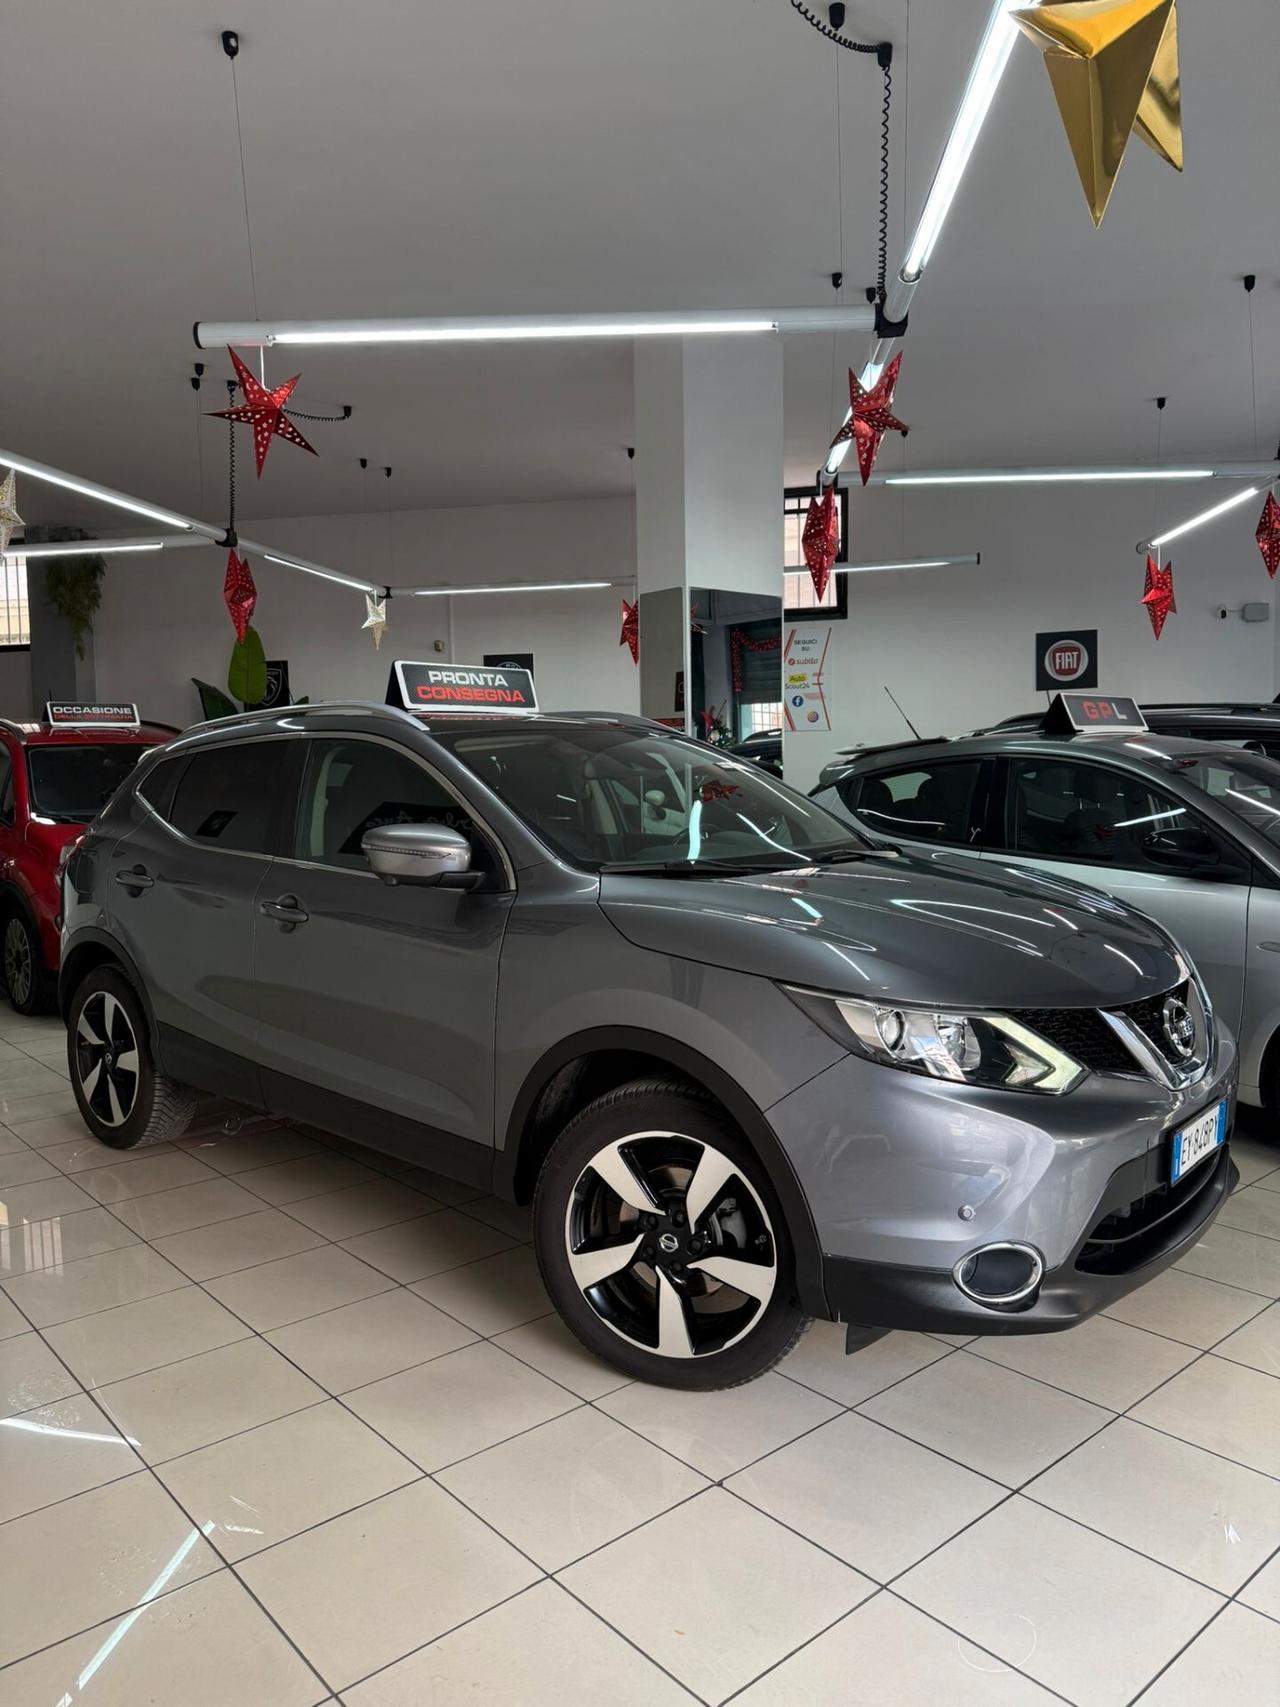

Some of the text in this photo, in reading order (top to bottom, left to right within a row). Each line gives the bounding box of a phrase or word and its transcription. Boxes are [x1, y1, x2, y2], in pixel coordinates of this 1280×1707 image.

[1055, 651, 1079, 670] FIAT
[427, 670, 509, 687] PRONTA
[416, 685, 526, 703] CONSEGNA
[53, 706, 133, 714] OCCASIONE
[1082, 700, 1128, 720] GPL
